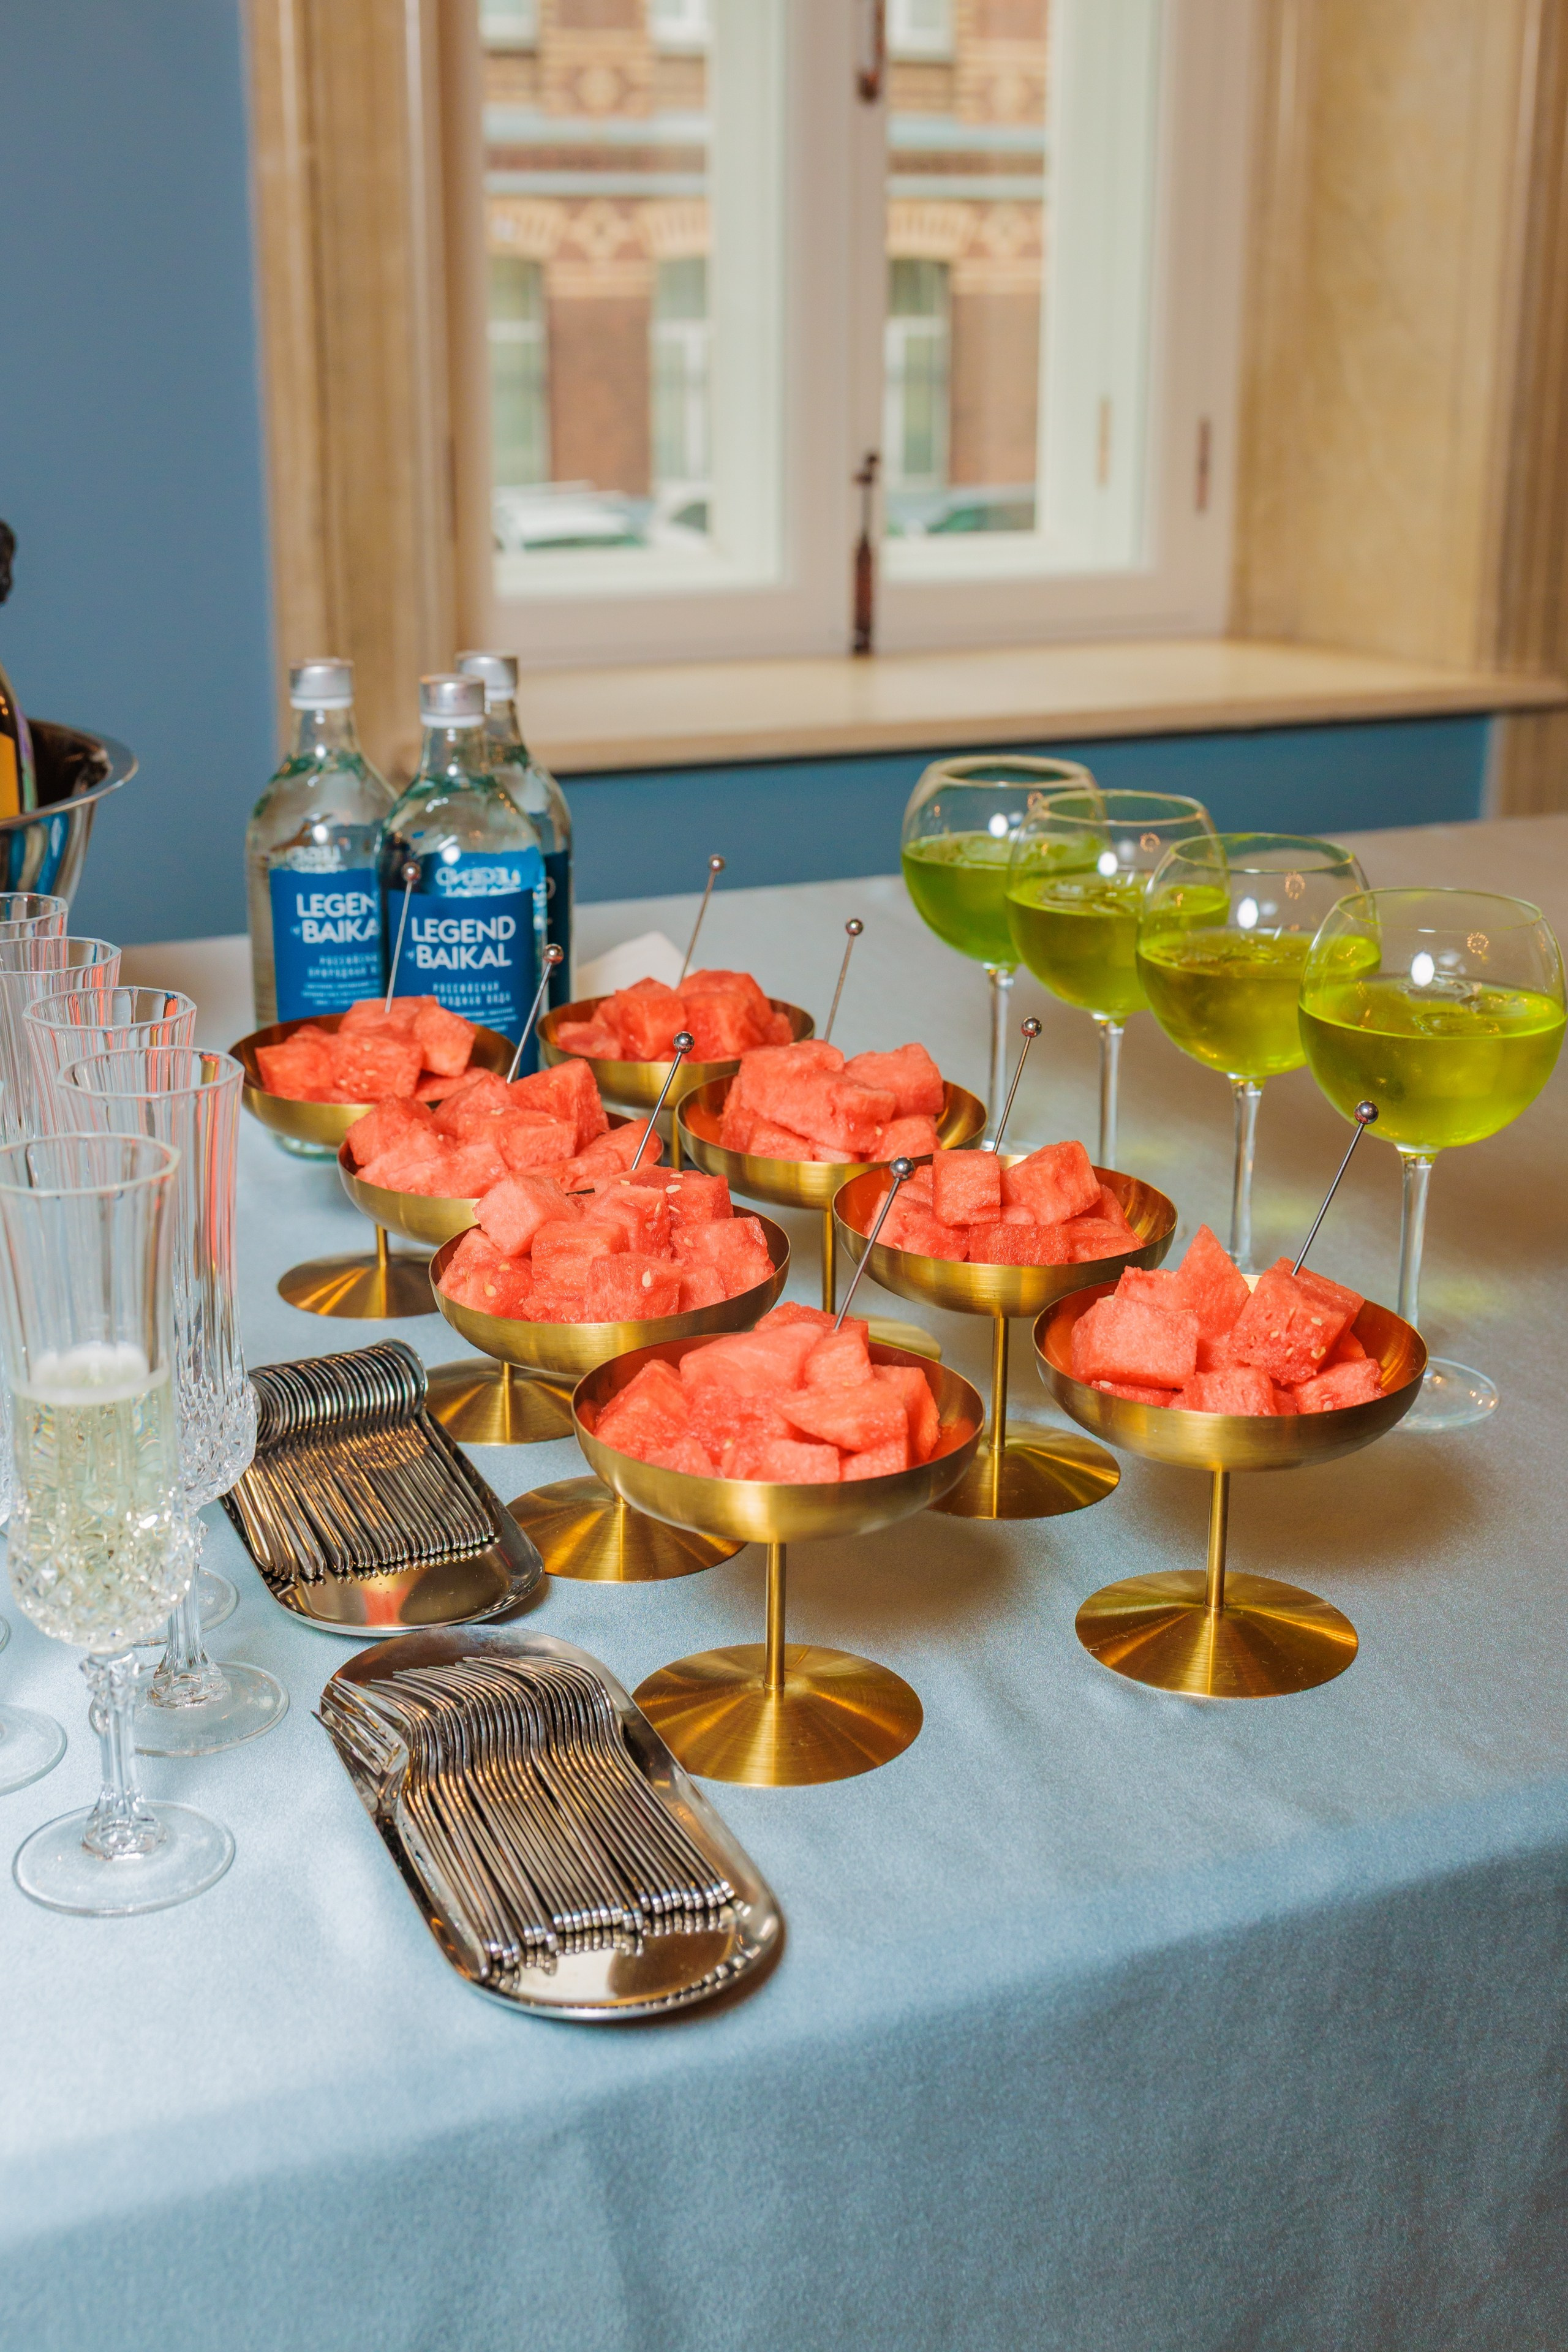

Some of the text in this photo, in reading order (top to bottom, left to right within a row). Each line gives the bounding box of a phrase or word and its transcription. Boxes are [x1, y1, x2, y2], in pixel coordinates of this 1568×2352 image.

[296, 892, 377, 918] LEGEN
[302, 918, 380, 944] BAIKA
[411, 915, 516, 944] LEGEND
[416, 943, 513, 970] BAIKAL
